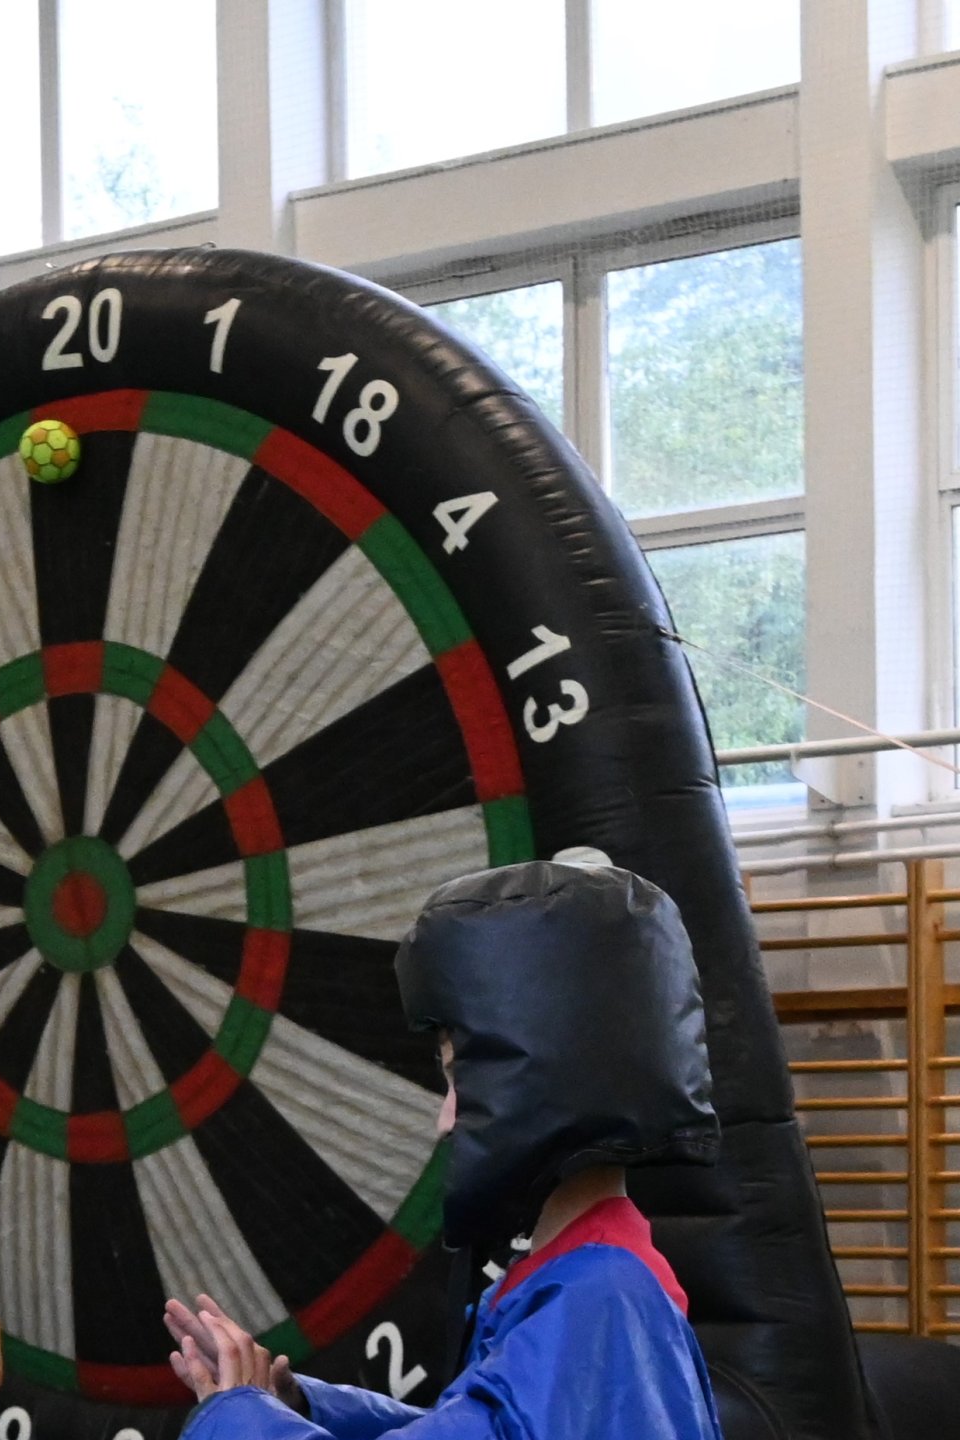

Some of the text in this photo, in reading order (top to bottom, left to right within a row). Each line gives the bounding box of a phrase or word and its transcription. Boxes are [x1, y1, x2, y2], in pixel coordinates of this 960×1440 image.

[42, 287, 123, 371] 20
[204, 297, 242, 374] 1
[312, 352, 399, 457] 18
[432, 490, 499, 555] 4
[506, 624, 590, 743] 13
[366, 1321, 428, 1400] 2
